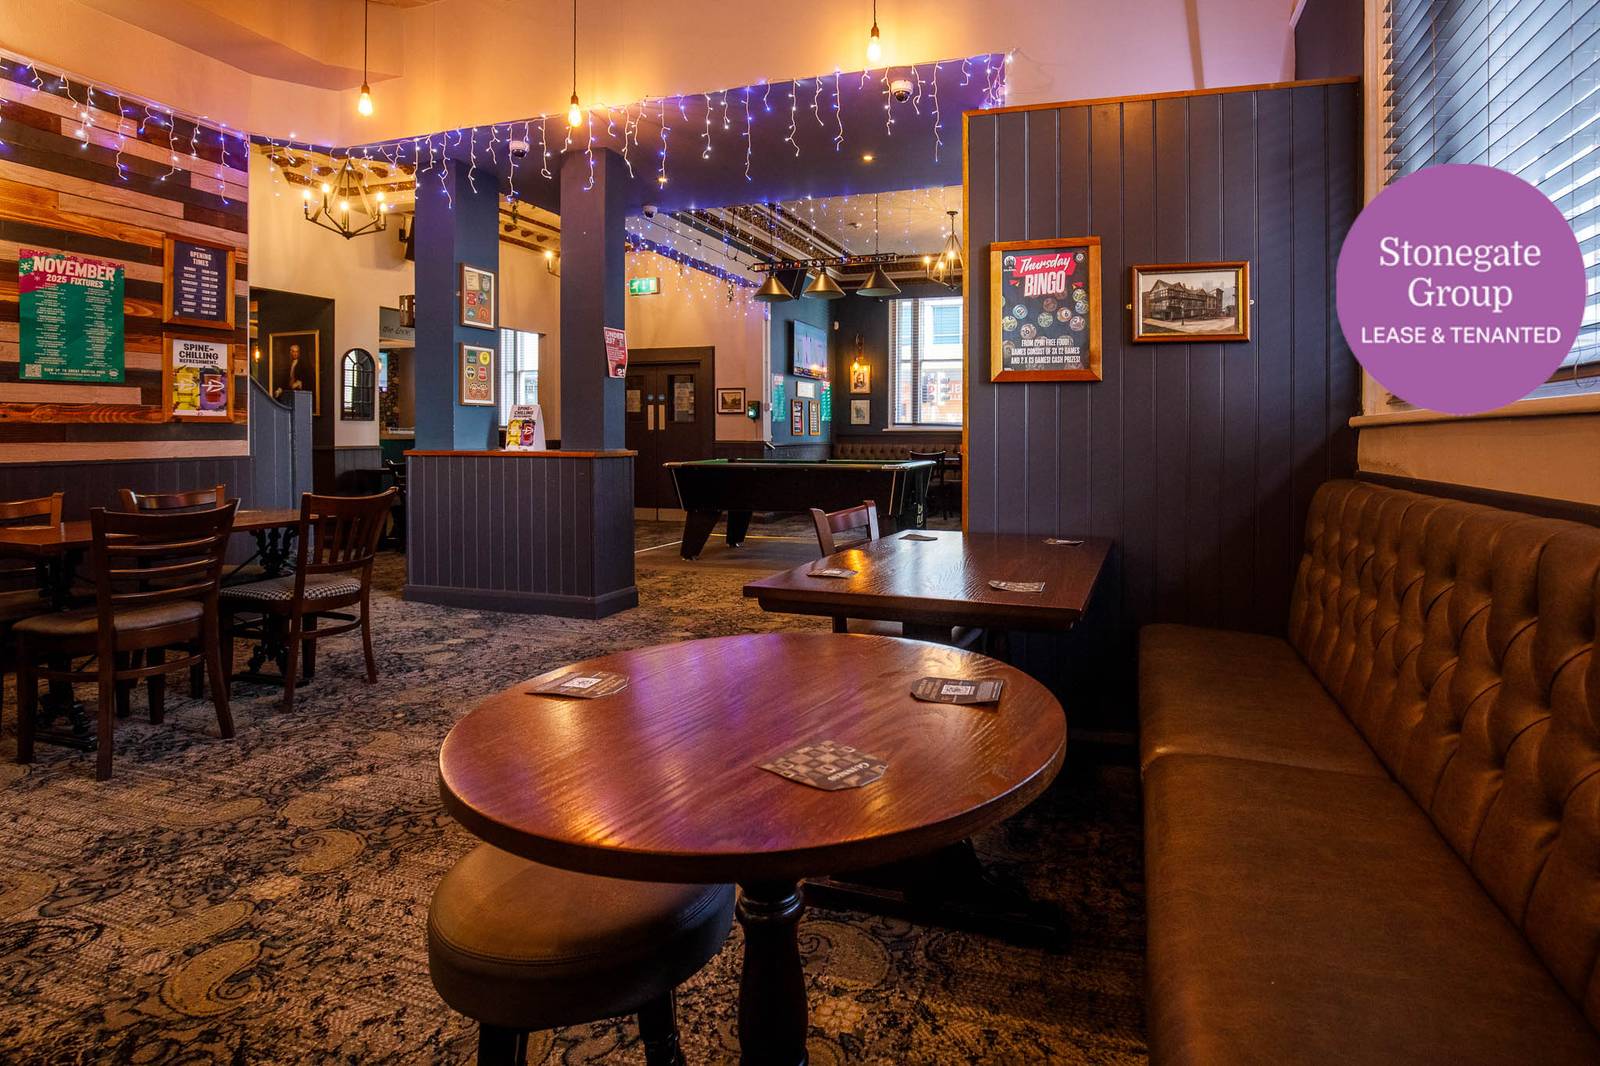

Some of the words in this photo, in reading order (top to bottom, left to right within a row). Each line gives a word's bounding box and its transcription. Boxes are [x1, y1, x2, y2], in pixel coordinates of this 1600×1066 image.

[32, 256, 115, 282] NOVEMBER
[1020, 254, 1070, 274] Thursday
[46, 274, 67, 283] 2025
[70, 277, 104, 289] FIXTURES
[1023, 271, 1066, 297] BINGO
[184, 343, 214, 352] SPINE-
[1064, 346, 1080, 355] GAMES
[179, 351, 219, 360] CHILLING
[1011, 356, 1021, 364] AND
[1051, 355, 1063, 363] CASH
